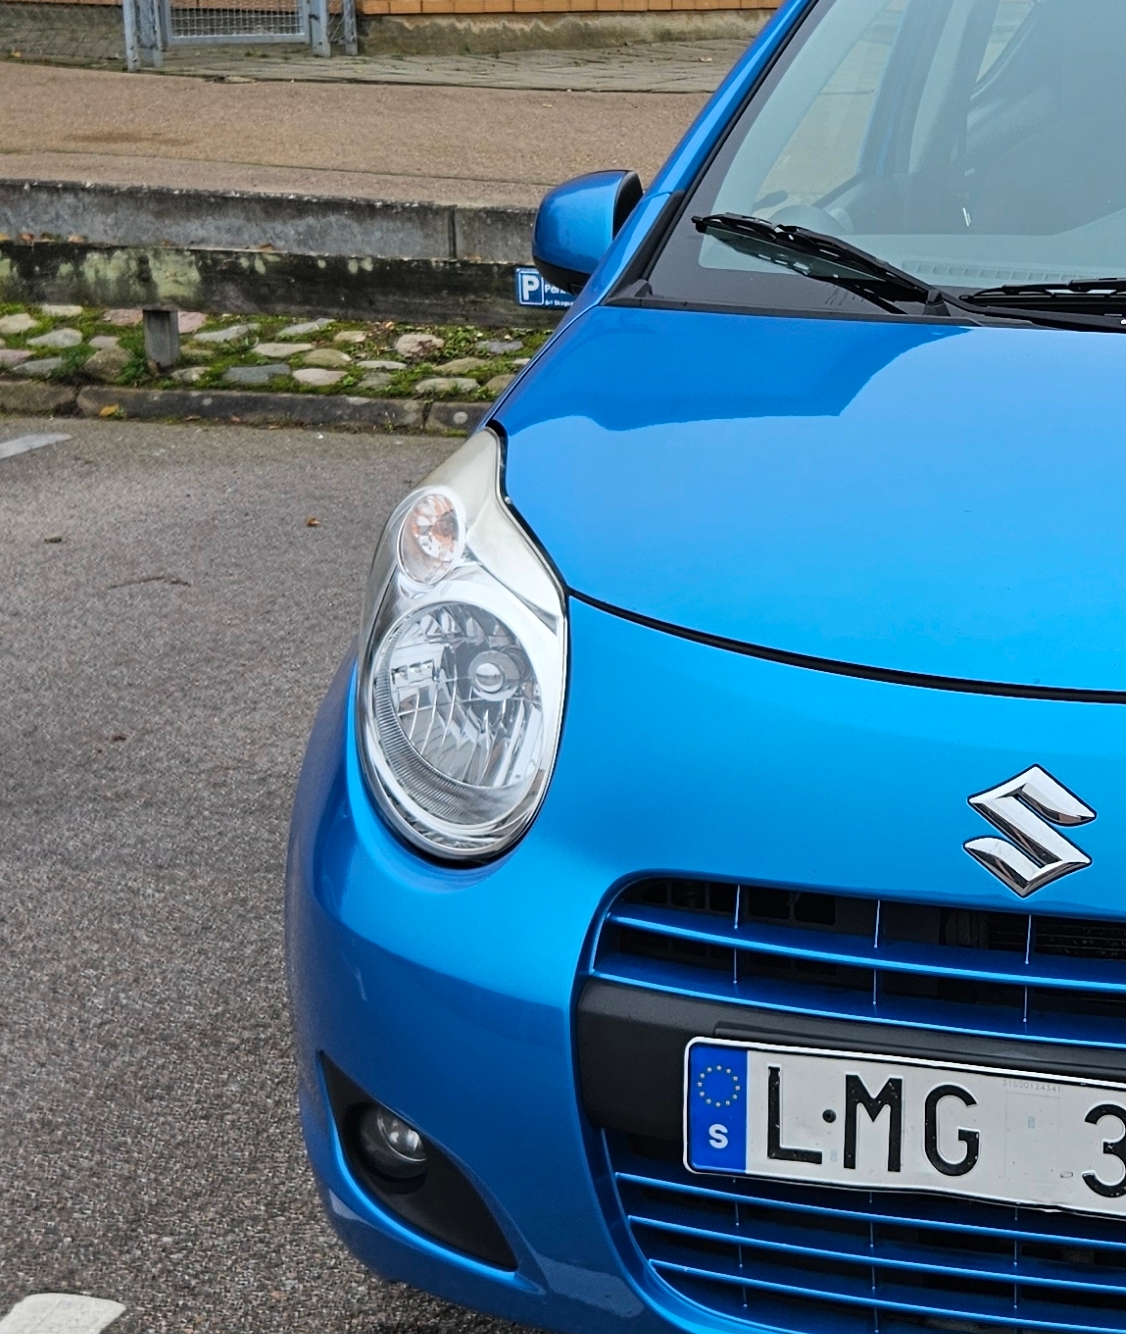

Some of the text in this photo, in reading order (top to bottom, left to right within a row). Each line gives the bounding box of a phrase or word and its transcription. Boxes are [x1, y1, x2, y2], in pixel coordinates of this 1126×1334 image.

[522, 274, 540, 301] P
[767, 1066, 980, 1177] LMG
[708, 1123, 729, 1150] S
